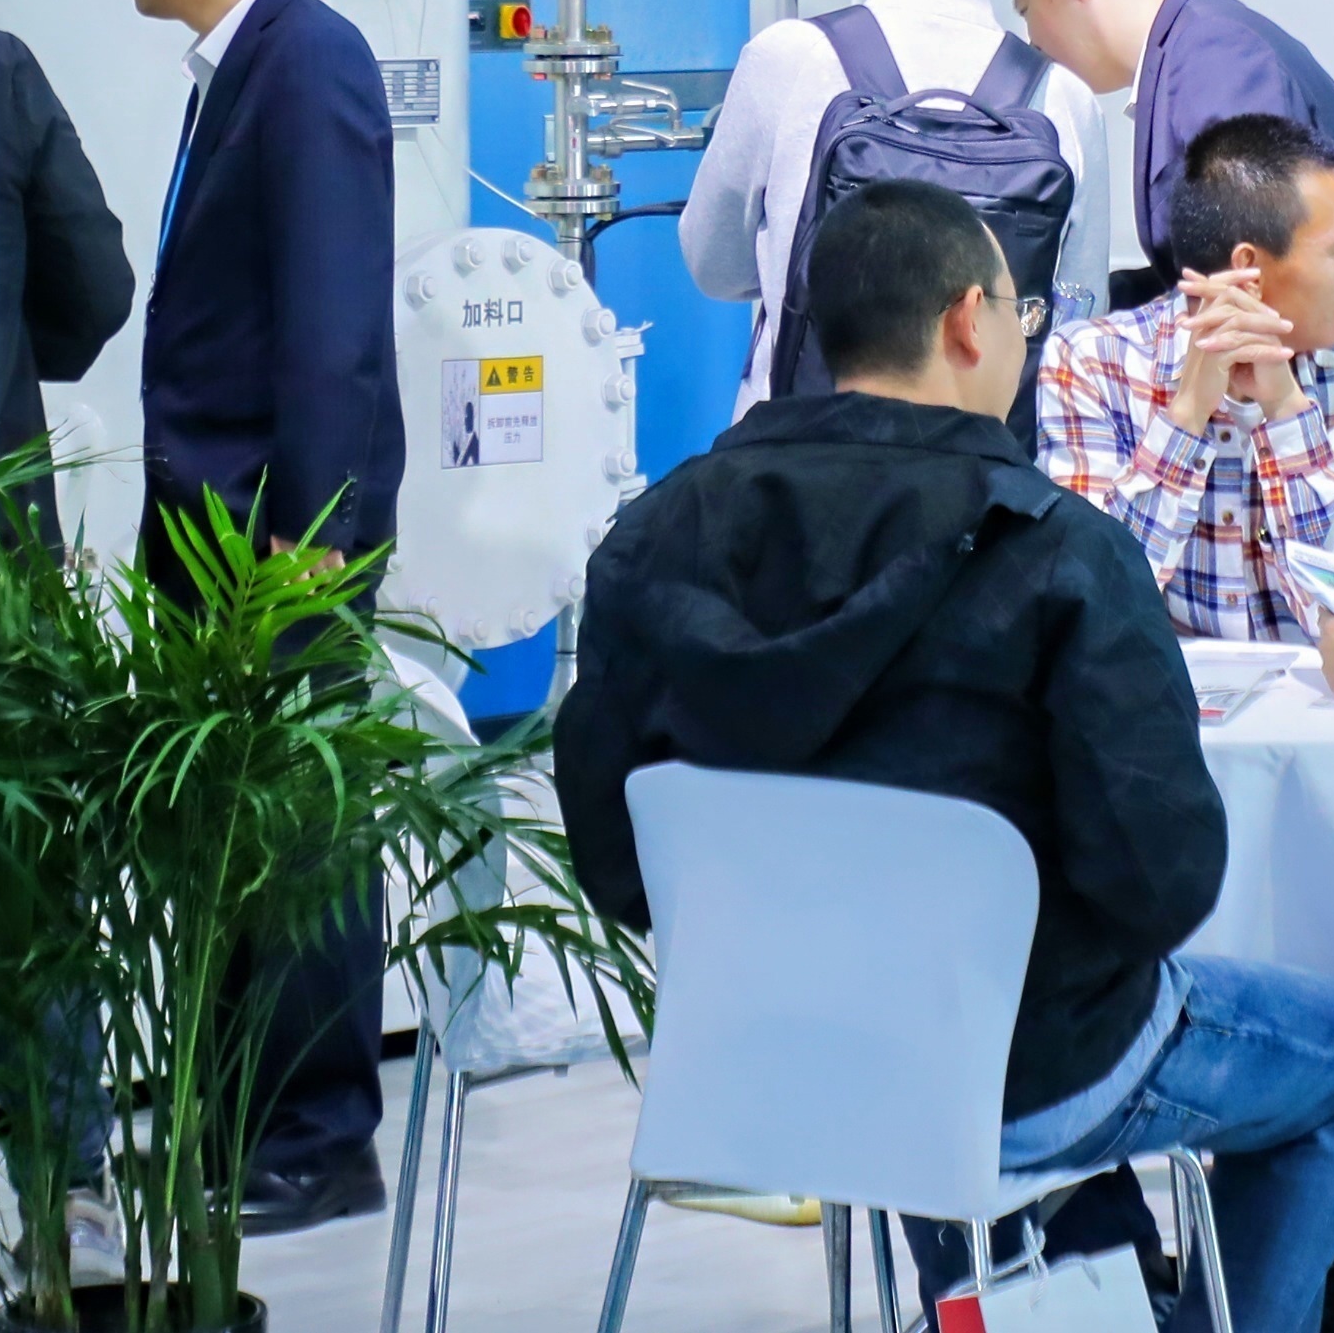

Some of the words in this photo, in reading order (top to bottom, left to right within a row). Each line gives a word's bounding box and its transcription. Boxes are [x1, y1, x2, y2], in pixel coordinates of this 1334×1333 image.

[462, 299, 524, 328] 加料口
[507, 365, 534, 384] 警告
